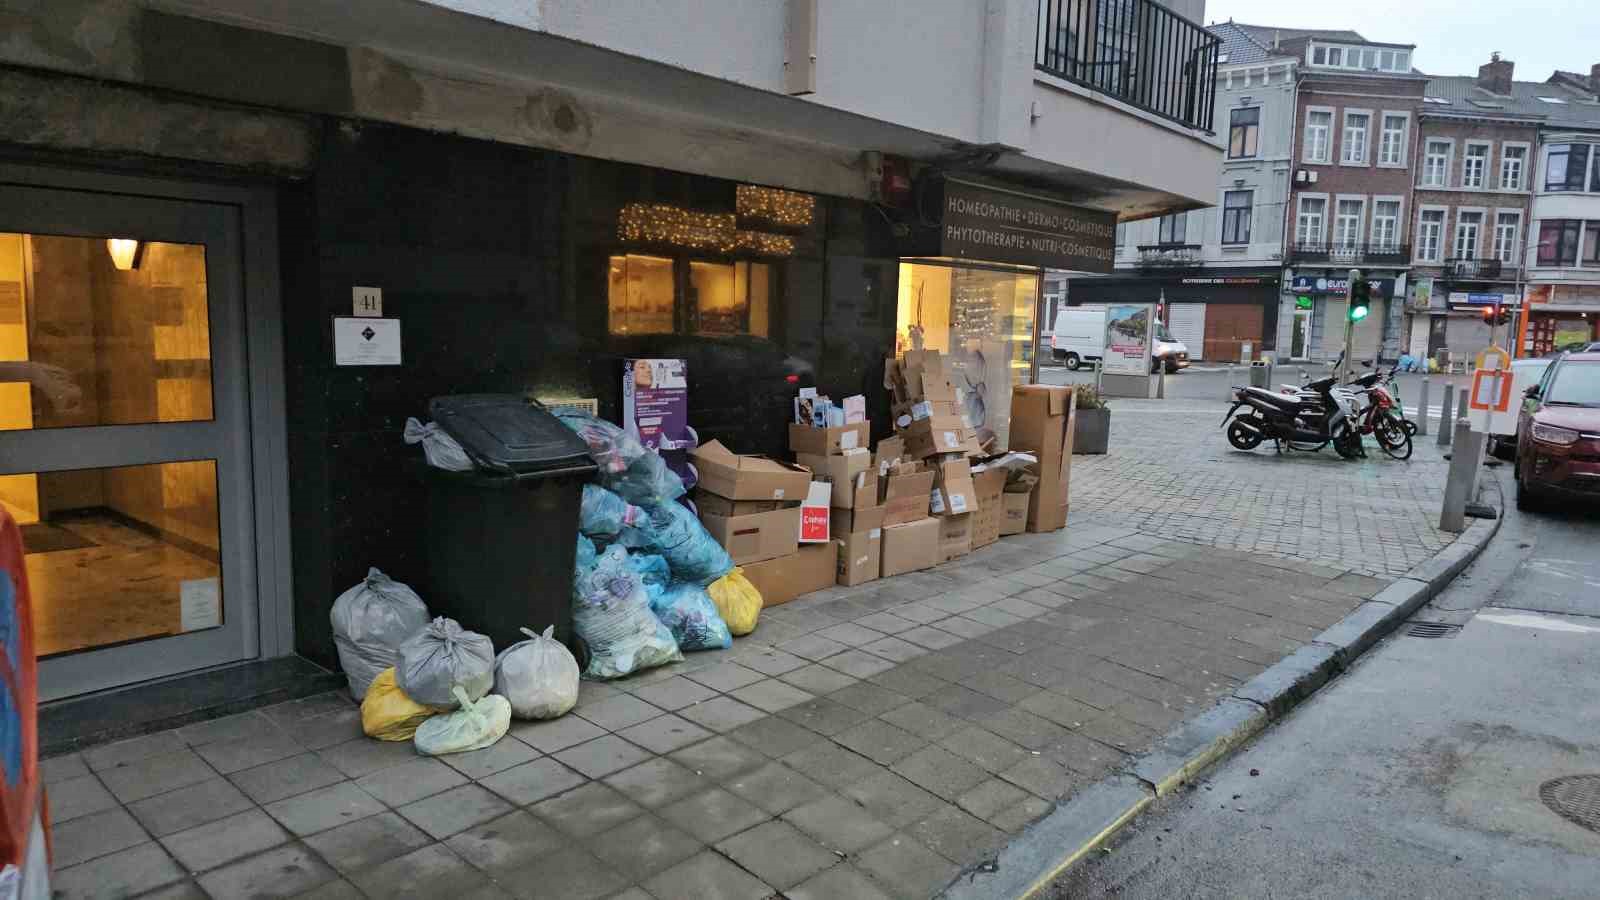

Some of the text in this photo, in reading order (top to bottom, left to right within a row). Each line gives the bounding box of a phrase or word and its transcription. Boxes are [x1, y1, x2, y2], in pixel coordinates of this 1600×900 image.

[948, 197, 1021, 223] HOMEOPATHIE
[947, 225, 1025, 249] PHYTOTHERAPIE
[360, 295, 377, 311] 41
